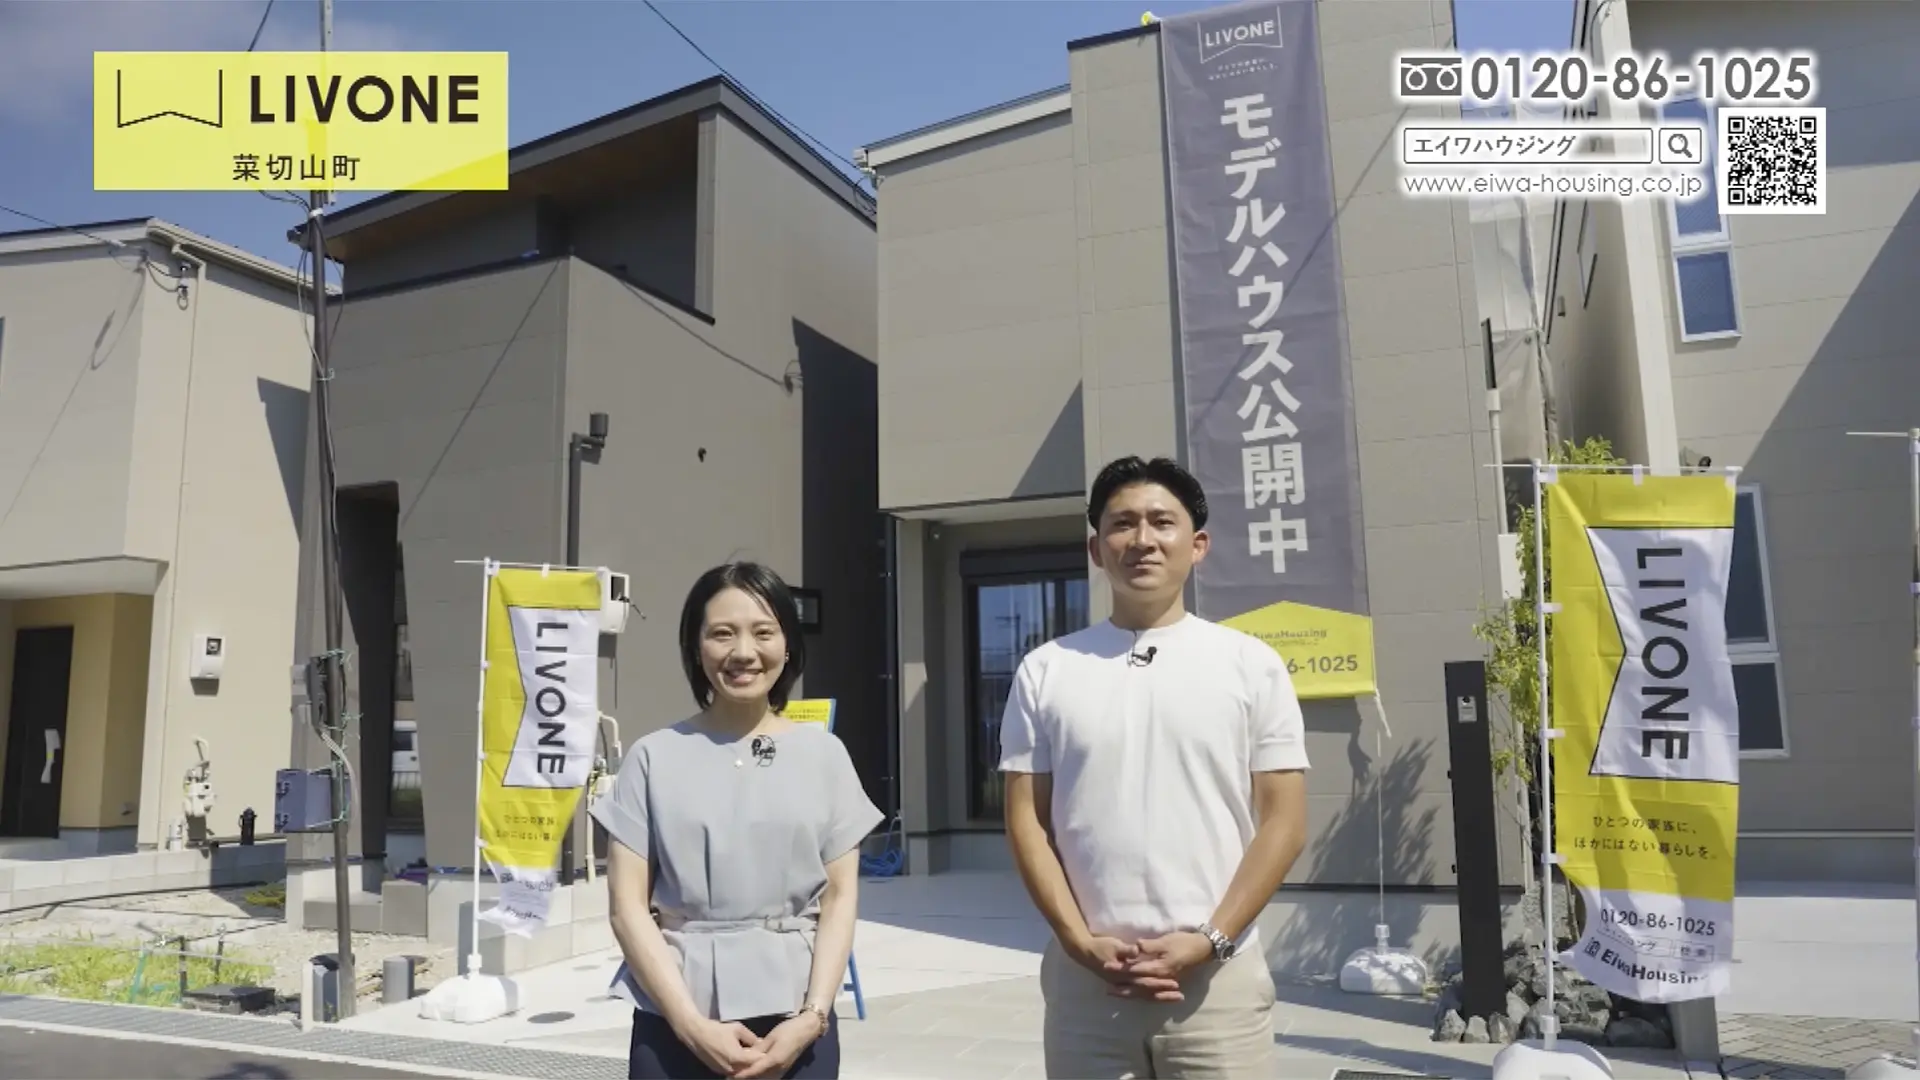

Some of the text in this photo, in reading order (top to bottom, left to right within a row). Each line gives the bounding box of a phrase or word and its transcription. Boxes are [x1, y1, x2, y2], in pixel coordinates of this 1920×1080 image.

[1205, 20, 1275, 47] LIVONE
[1220, 93, 1309, 574] モデルハウス公開中
[535, 622, 568, 774] LIVONE
[1636, 548, 1689, 760] LIVONE
[1601, 908, 1716, 936] 0120-86-1025
